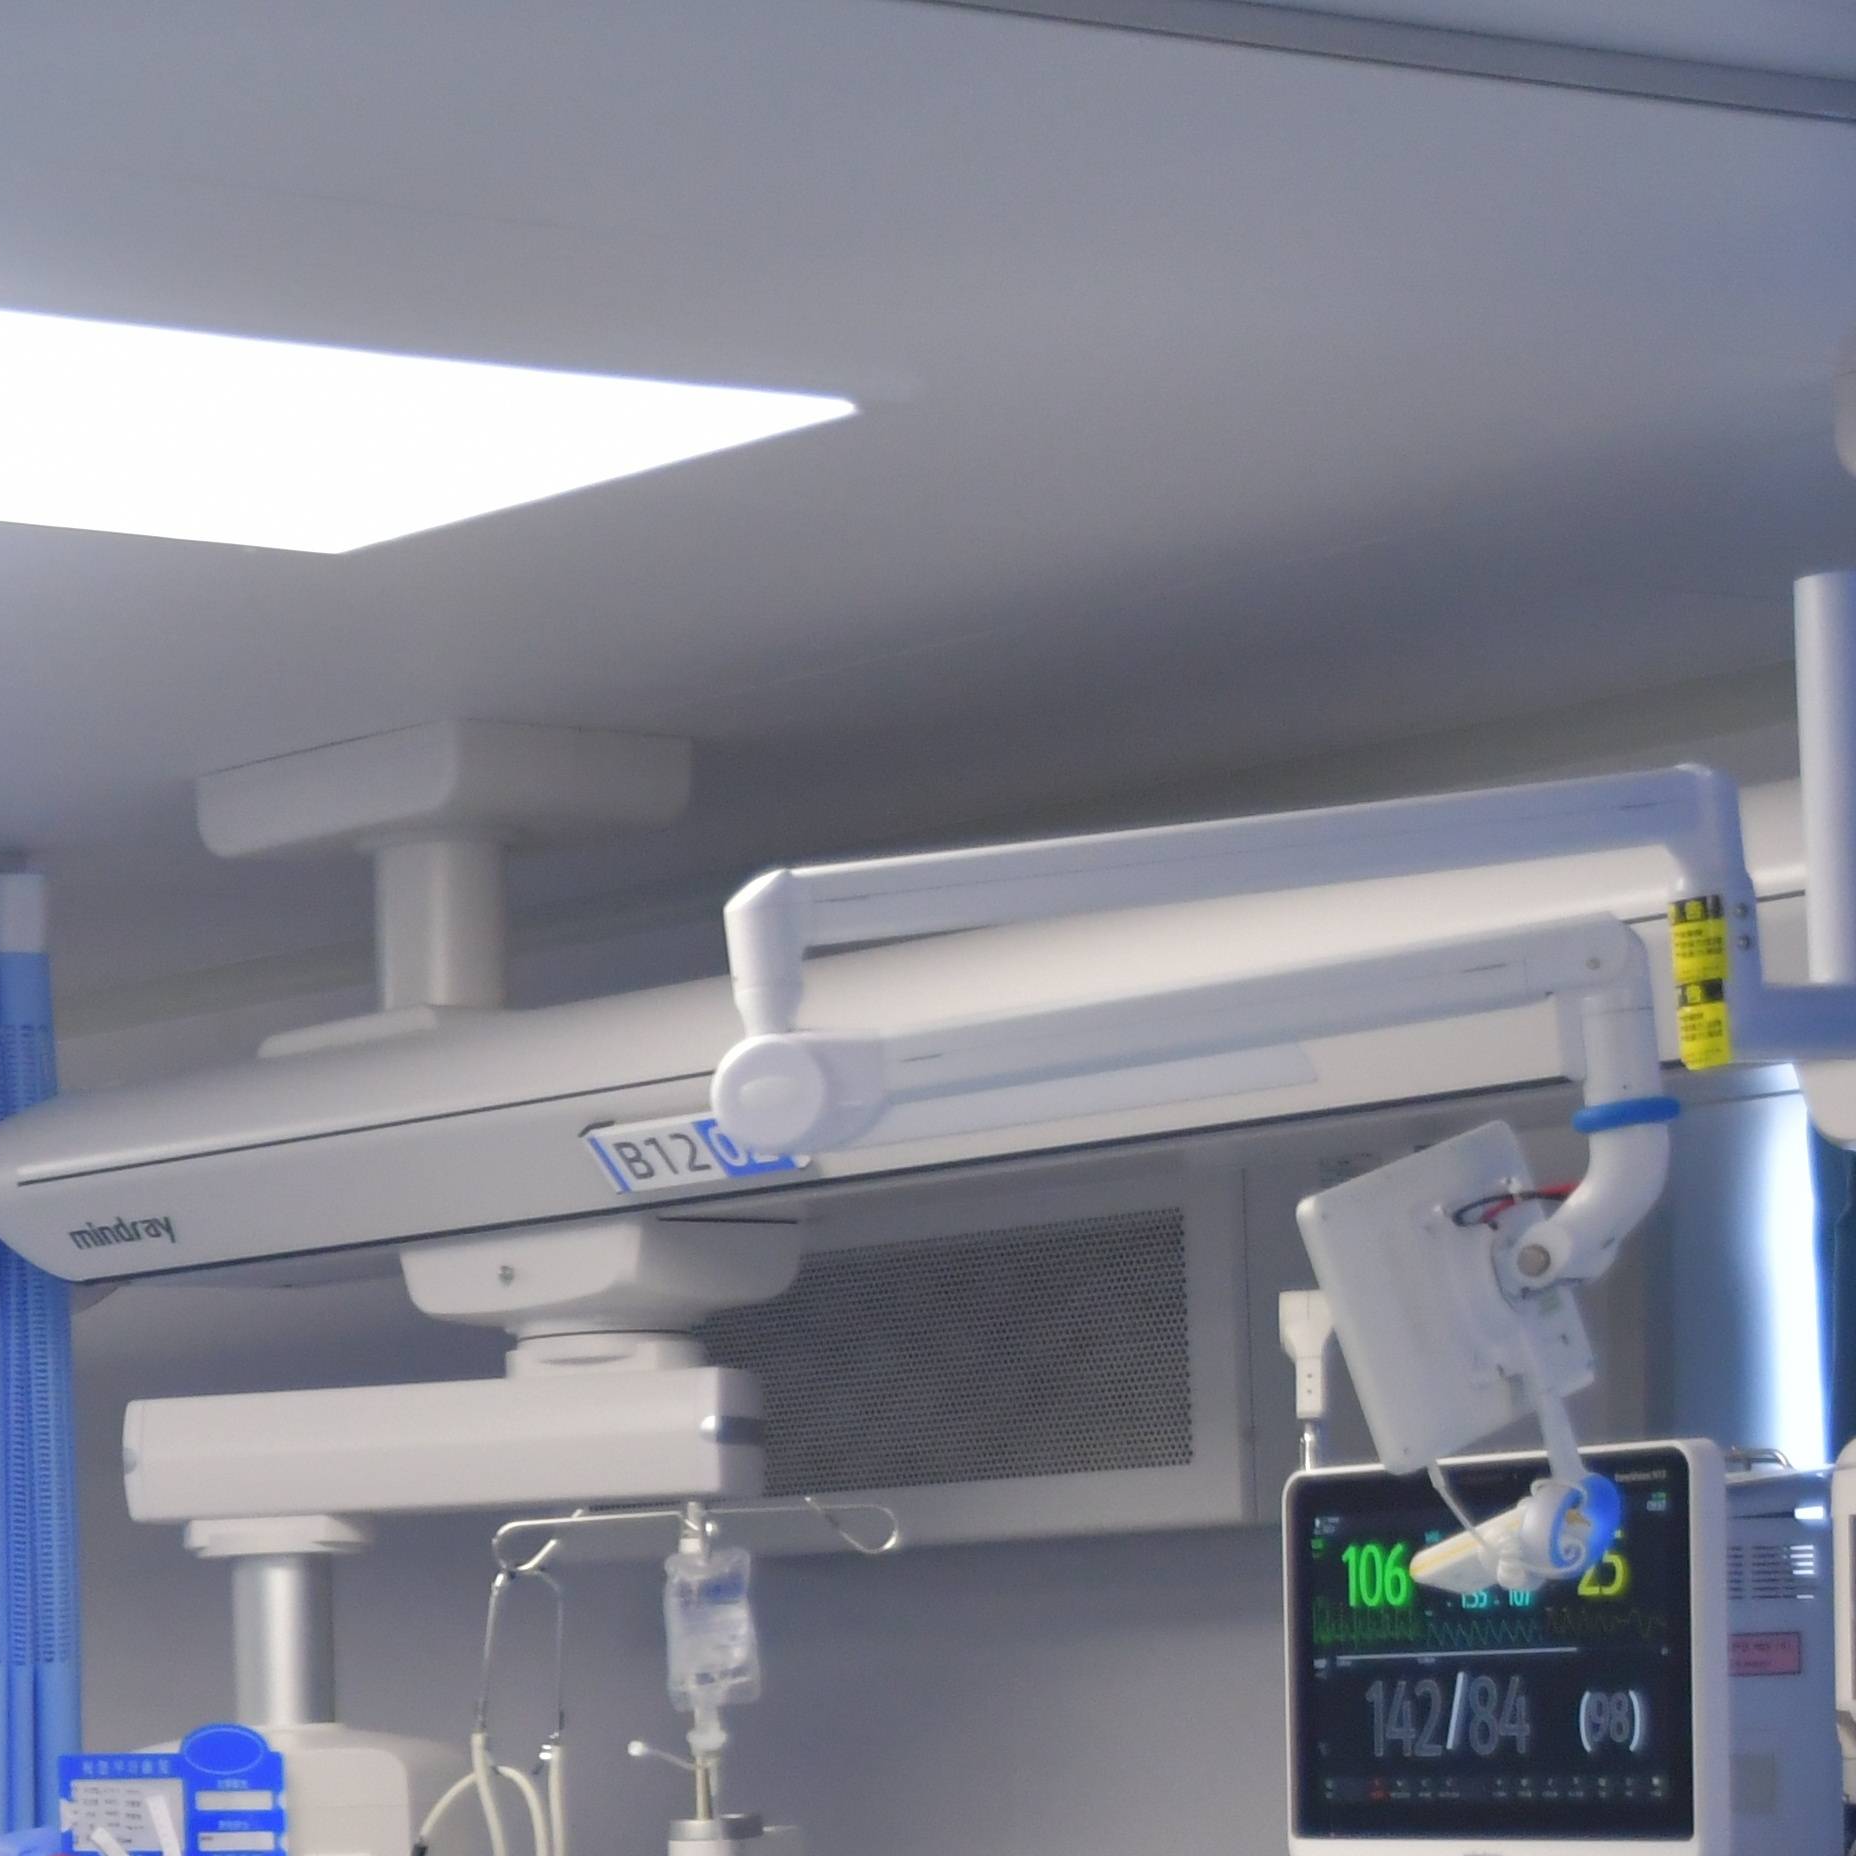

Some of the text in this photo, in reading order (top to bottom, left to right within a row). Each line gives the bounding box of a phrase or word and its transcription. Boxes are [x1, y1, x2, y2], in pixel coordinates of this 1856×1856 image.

[69, 1215, 177, 1250] mindray
[1341, 1543, 1409, 1607] 106
[1365, 1671, 1645, 1758] 142/84 (98)
